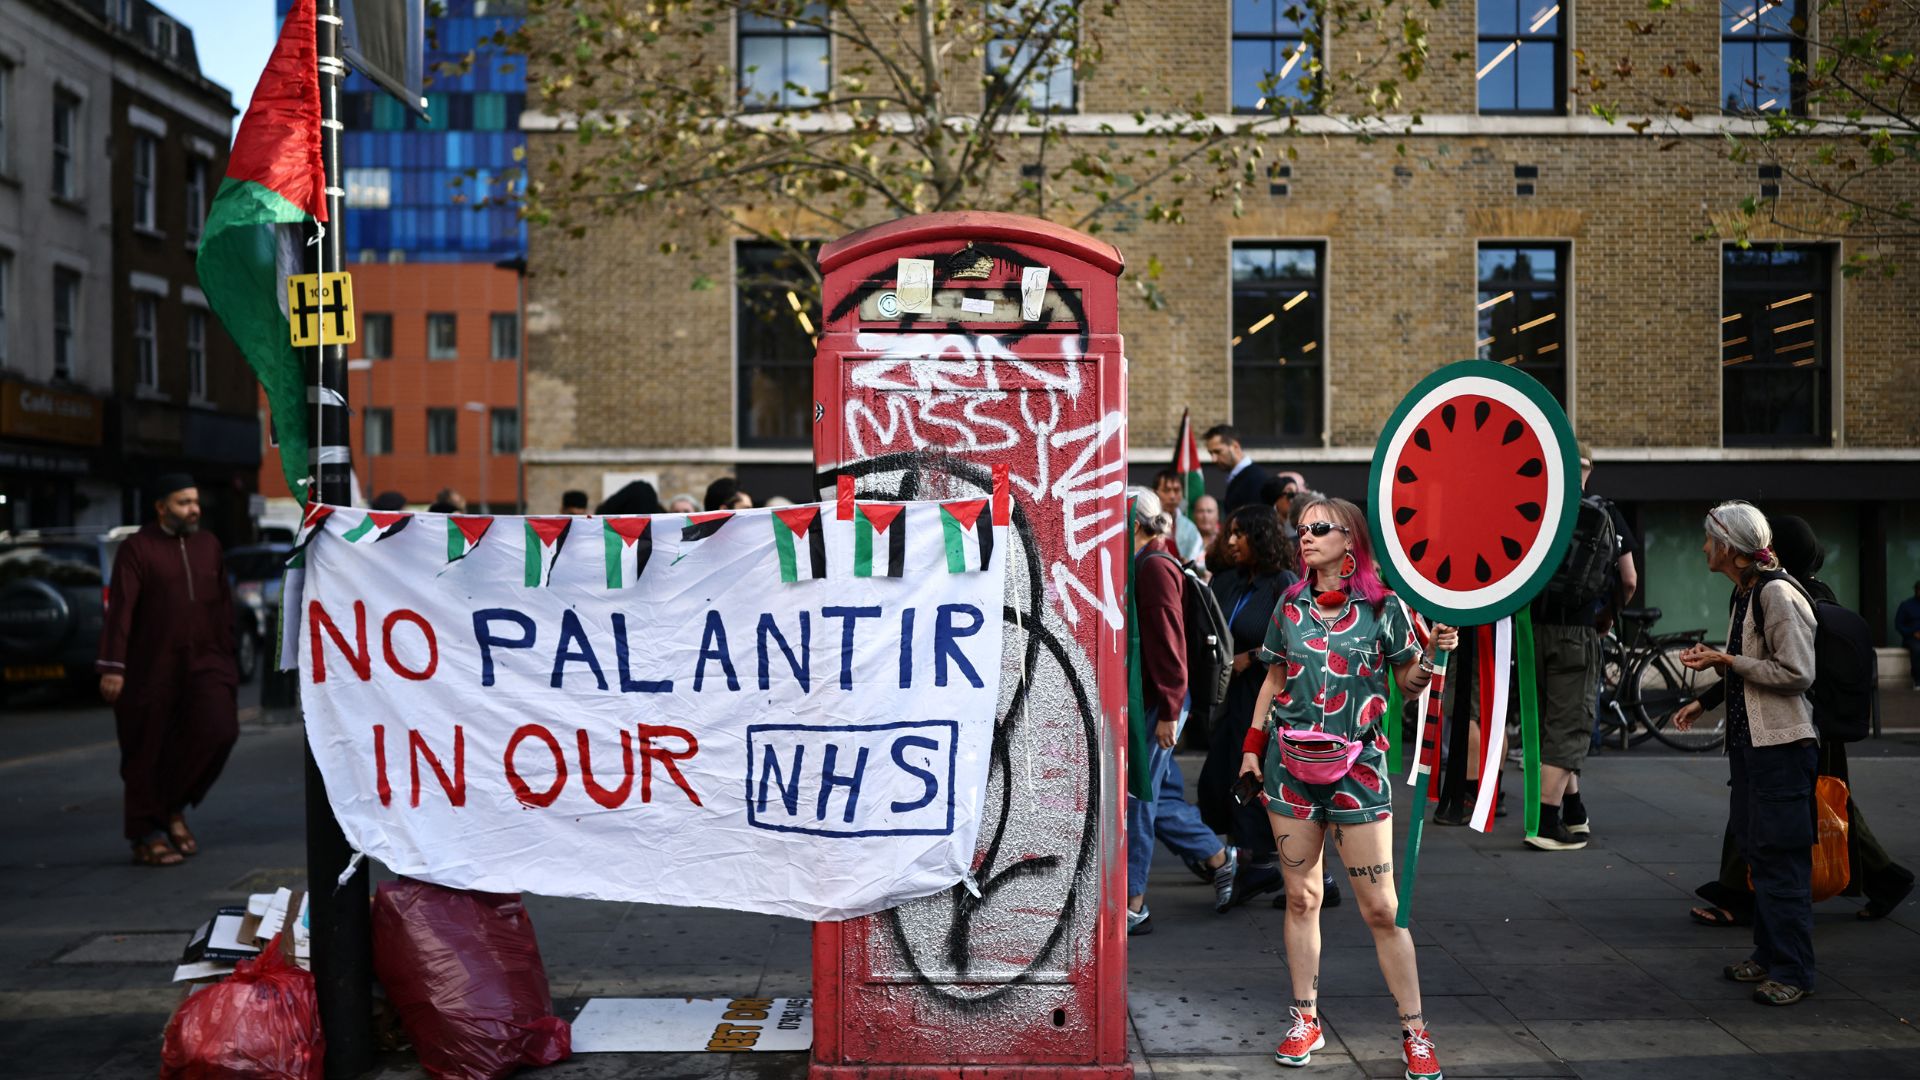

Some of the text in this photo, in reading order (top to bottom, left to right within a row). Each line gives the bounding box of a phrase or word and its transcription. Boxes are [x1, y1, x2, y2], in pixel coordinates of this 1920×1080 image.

[309, 599, 985, 695] NO PALANTIR
[373, 722, 939, 823] IN OUR NHS
